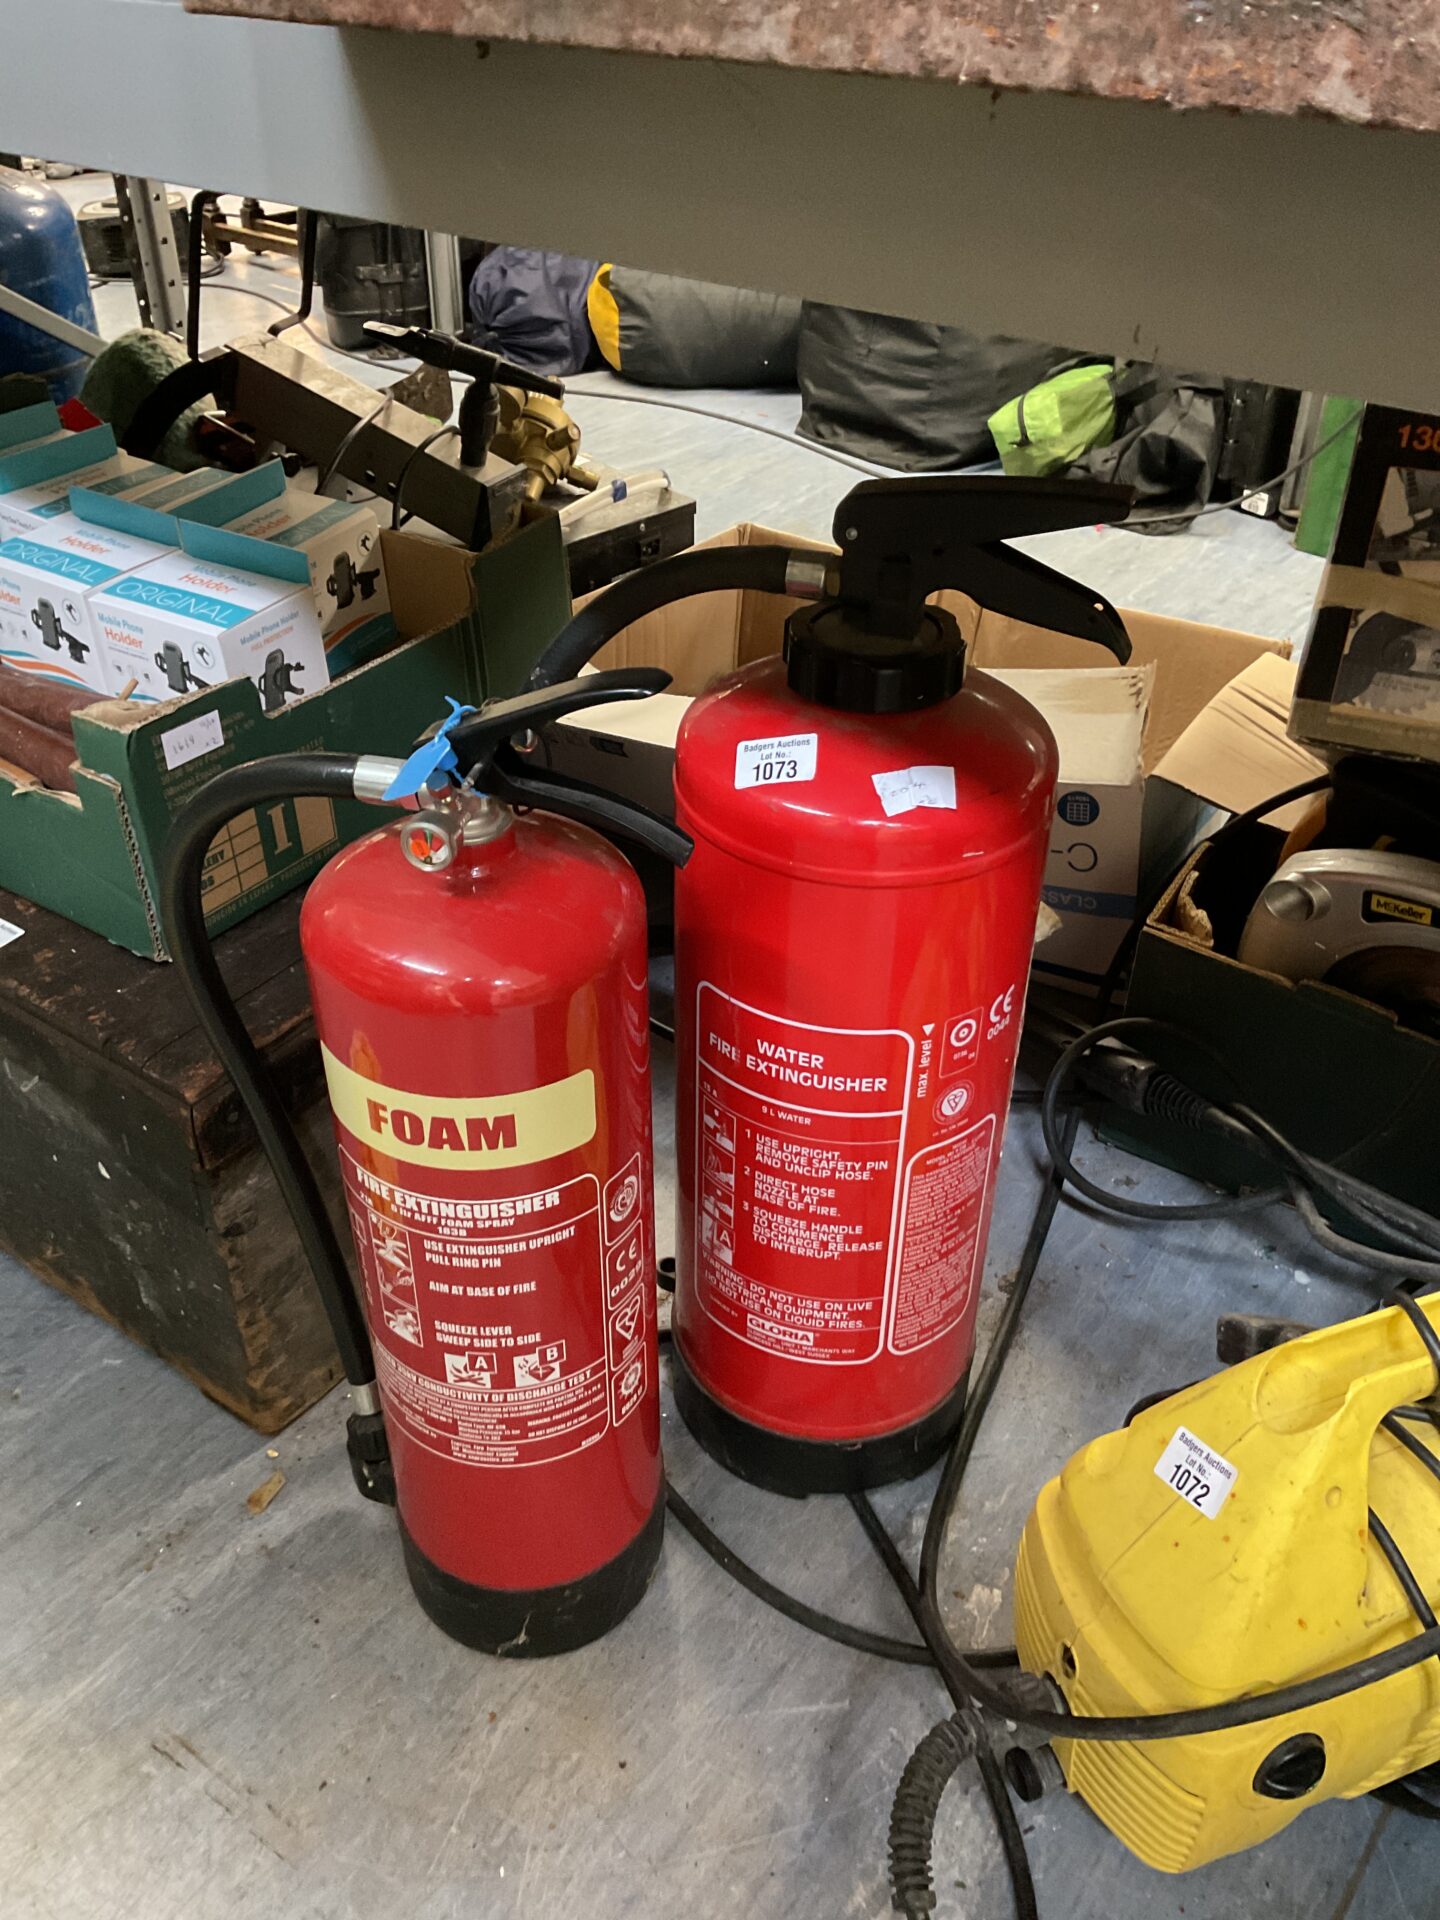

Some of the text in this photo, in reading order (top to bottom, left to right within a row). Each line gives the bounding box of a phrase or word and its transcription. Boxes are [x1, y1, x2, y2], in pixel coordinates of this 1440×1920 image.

[60, 535, 111, 555] Holder
[0, 541, 97, 583] ORIGINAL
[178, 573, 238, 594] Holder
[116, 582, 230, 625] ORIGINAL
[97, 612, 144, 635] Mobile Phone
[240, 611, 301, 647] Mobile Phone Holder
[104, 627, 144, 649] Holder
[744, 738, 811, 753] Badgers Auctions
[760, 751, 773, 760] Lot
[752, 760, 798, 782] 1073
[709, 1032, 888, 1092] FIRE EXTINGUISHER
[757, 1039, 824, 1070] WATER
[917, 1039, 932, 1099] max. level
[366, 1097, 518, 1152] FOAM
[762, 1106, 812, 1126] 9 L WATER
[745, 1128, 751, 1139] 1
[756, 1133, 779, 1150] USE
[755, 1144, 888, 1172] REMOVE SAFETY PIN
[755, 1154, 875, 1181] AND UNCLIP HOSE.
[356, 1166, 561, 1219] FIRE EXTINGUISHER
[744, 1166, 836, 1198] 2 DIRECT HOSE
[755, 1181, 820, 1205] NOZZLE AT
[754, 1189, 841, 1217] BASE OF FIRE.
[414, 1213, 438, 1225] AFFF
[441, 1218, 474, 1228] FOAM
[477, 1217, 516, 1228] SPRAY
[743, 1201, 863, 1235] 3 SQUEEZE HANDLE
[752, 1215, 844, 1243] TO COMMENCE
[424, 1225, 576, 1256] USE EXTINGUISHER UPRIGHT
[752, 1232, 768, 1246] TO
[828, 1241, 884, 1253] RELEASE
[425, 1253, 502, 1269] PULL RING PIN
[429, 1281, 537, 1297] AIM AT BASE OF FIRE
[715, 1270, 773, 1308] ELECTRICAL
[750, 1282, 767, 1297] DO
[769, 1290, 794, 1304] NOT
[797, 1298, 821, 1310] USE
[826, 1301, 844, 1311] ON
[847, 1301, 873, 1311] LIVE
[718, 1282, 738, 1300] NOT
[740, 1295, 761, 1315] USE
[764, 1306, 782, 1319] ON
[784, 1314, 825, 1329] LIQUID
[434, 1320, 512, 1336] SQUEEZE LEVER
[436, 1332, 542, 1348] SWEEP SIDE TO SIDE
[748, 1317, 813, 1345] GLORIA
[475, 1356, 488, 1369] A
[546, 1347, 558, 1361] B
[418, 1375, 489, 1402] CONDUCTIVITY
[492, 1392, 505, 1403] OF
[507, 1381, 567, 1402] DISCHARGE
[567, 1369, 592, 1388] TEST
[1179, 1432, 1233, 1480] Badgers Auctions
[1185, 1454, 1197, 1468] Lot
[1169, 1463, 1211, 1508] 1072
